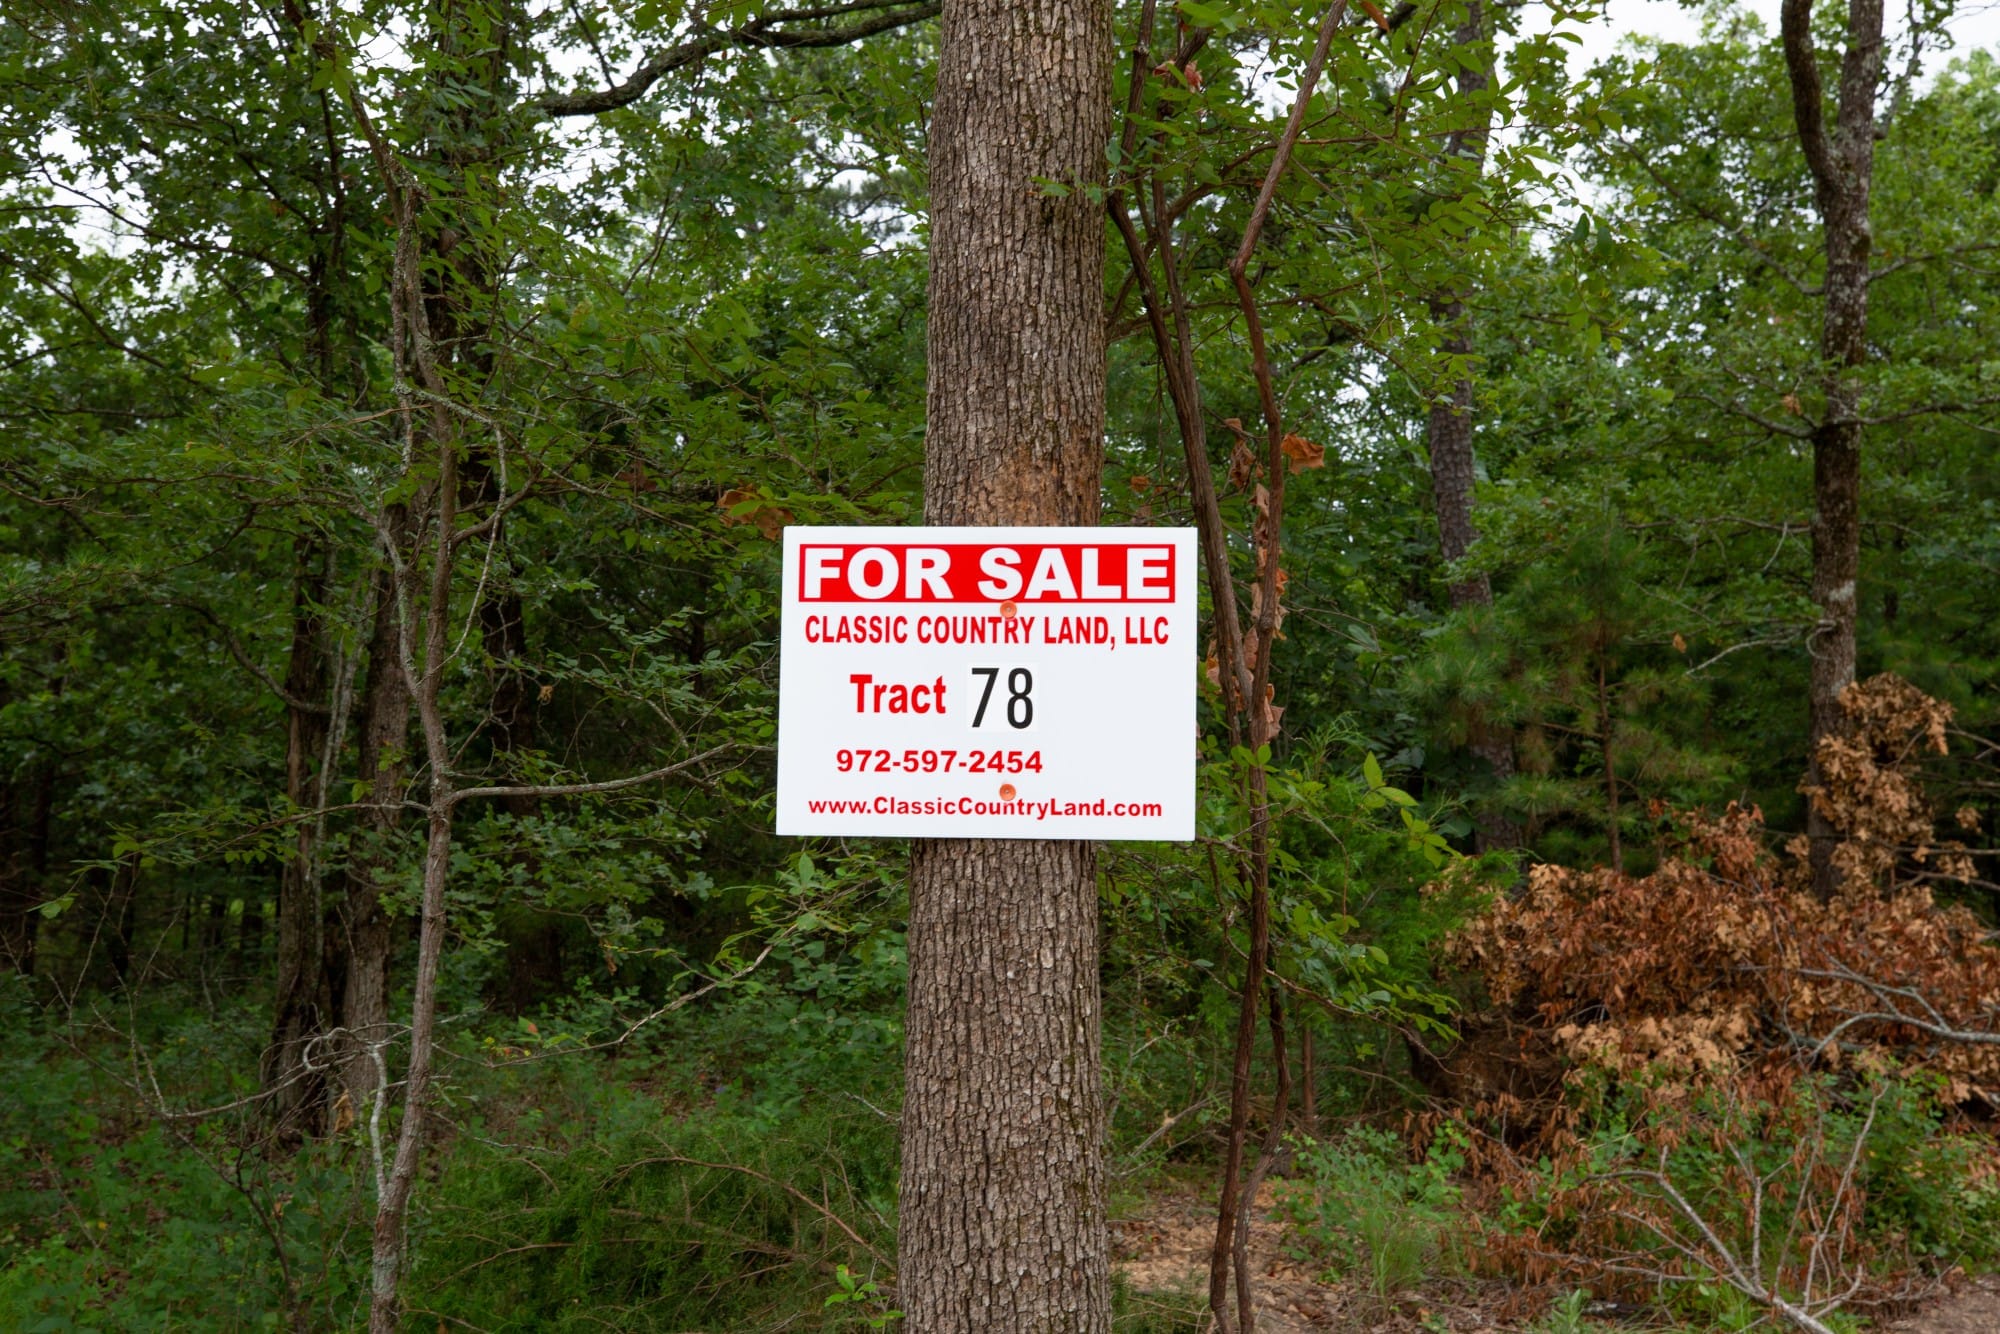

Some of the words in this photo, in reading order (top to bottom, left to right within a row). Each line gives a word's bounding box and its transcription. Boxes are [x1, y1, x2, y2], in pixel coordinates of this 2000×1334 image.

[804, 548, 953, 600] FOR
[977, 547, 1170, 600] SALE
[805, 615, 908, 643] CLASSIC
[917, 615, 1035, 644] COUNTRY
[1044, 616, 1116, 651] LAND,
[1125, 616, 1169, 645] LLC
[849, 674, 947, 714] Tract
[971, 667, 1034, 729] 78
[836, 749, 1043, 773] 972-597-2454
[808, 796, 1162, 820] www.ClassicCountryLand.com
